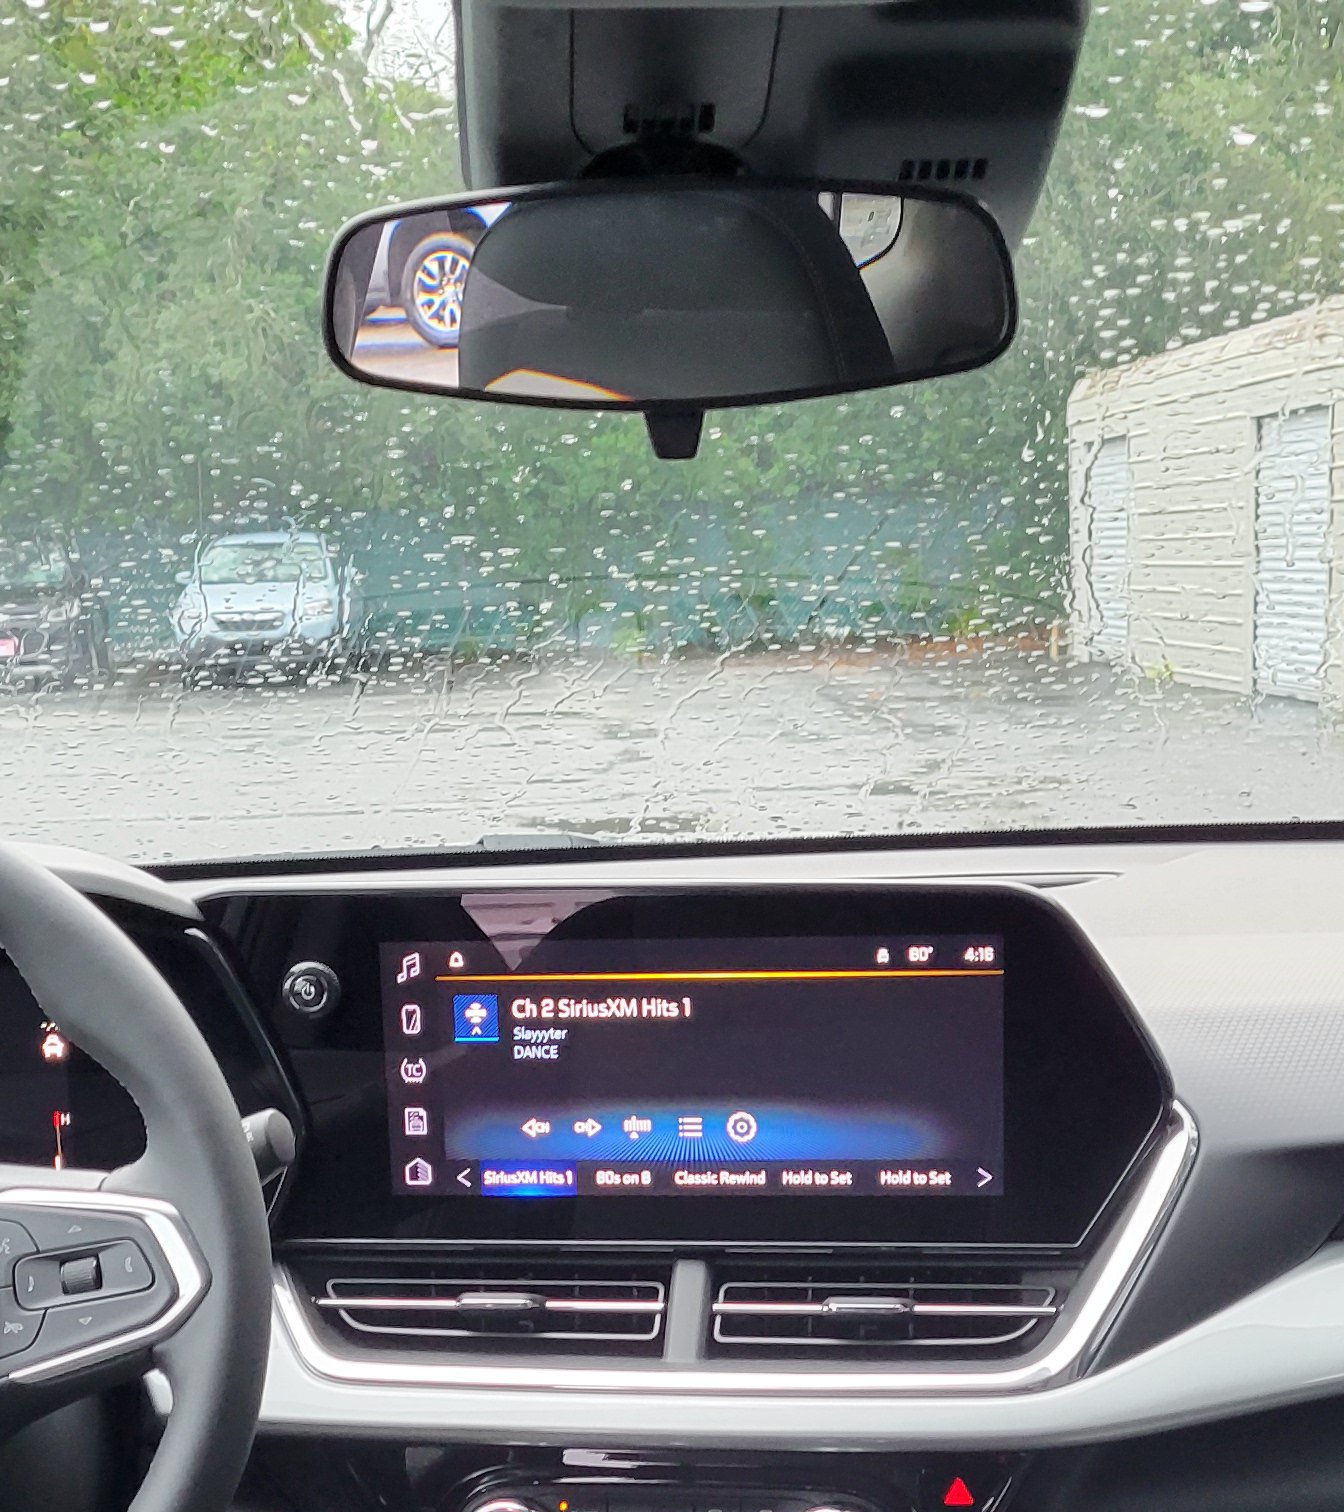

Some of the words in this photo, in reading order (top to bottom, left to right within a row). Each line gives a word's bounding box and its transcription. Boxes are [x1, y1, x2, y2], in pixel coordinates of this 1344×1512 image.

[511, 998, 537, 1018] Ch
[541, 998, 554, 1018] 2
[558, 998, 637, 1018] SiriusXM
[642, 998, 679, 1018] Hits
[682, 997, 691, 1018] 1
[512, 1026, 568, 1043] Slayyyter
[513, 1045, 559, 1059] DANCE
[483, 1170, 537, 1185] SiriusXM
[539, 1170, 564, 1185] Hits
[566, 1170, 573, 1186] 1
[622, 1173, 639, 1185] on
[674, 1171, 718, 1185] Classic
[720, 1171, 766, 1185] Rewind
[782, 1170, 812, 1185] Hold
[814, 1172, 828, 1185] to
[830, 1170, 852, 1185] Set
[880, 1170, 911, 1185] Hold
[913, 1172, 927, 1185] to
[929, 1170, 952, 1185] Set
